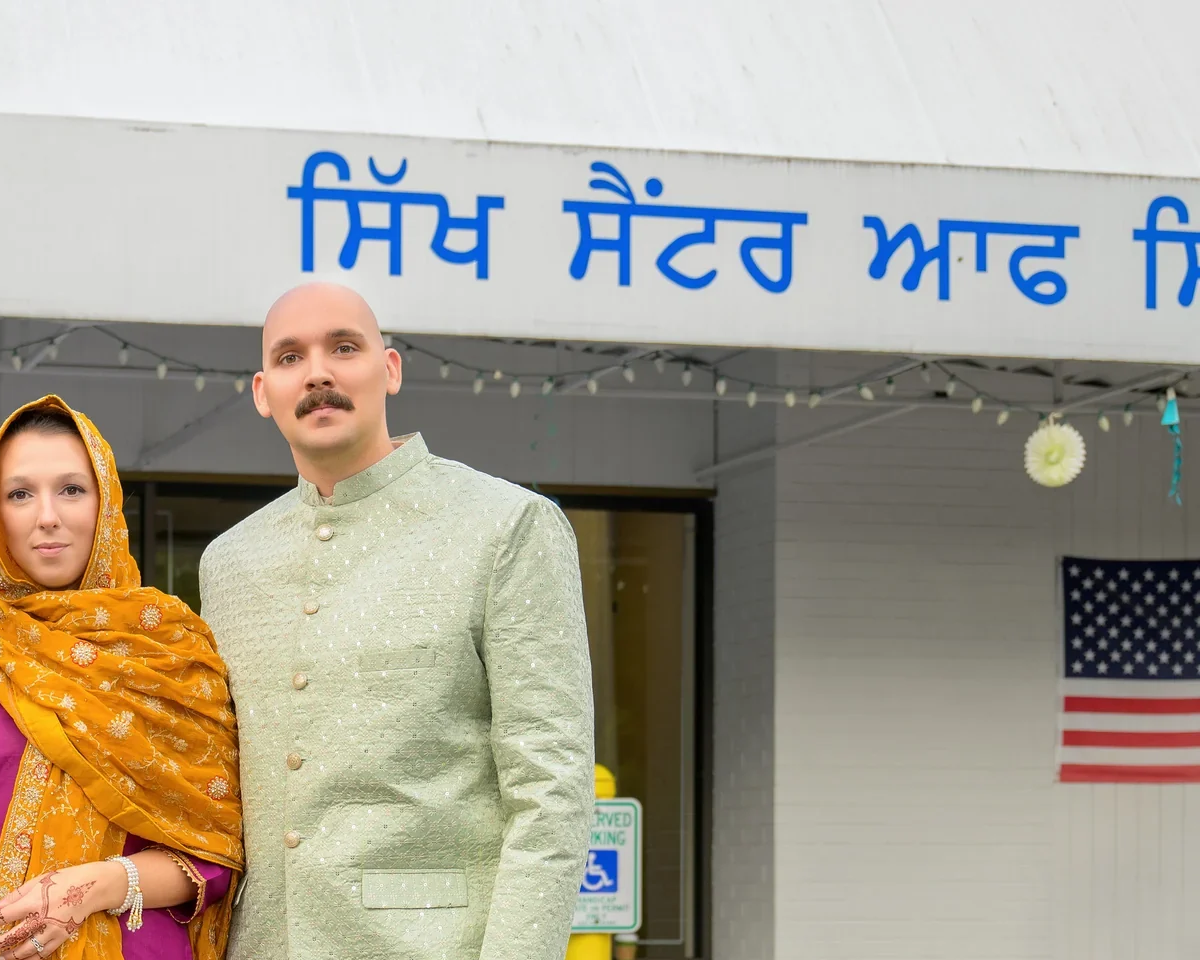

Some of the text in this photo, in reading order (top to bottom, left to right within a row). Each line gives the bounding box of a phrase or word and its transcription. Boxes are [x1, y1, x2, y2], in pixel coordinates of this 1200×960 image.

[287, 150, 505, 281] ਸਿੱਖ
[562, 161, 809, 294] ਸੈਂਟਰ
[862, 215, 1081, 306] ਆਫ
